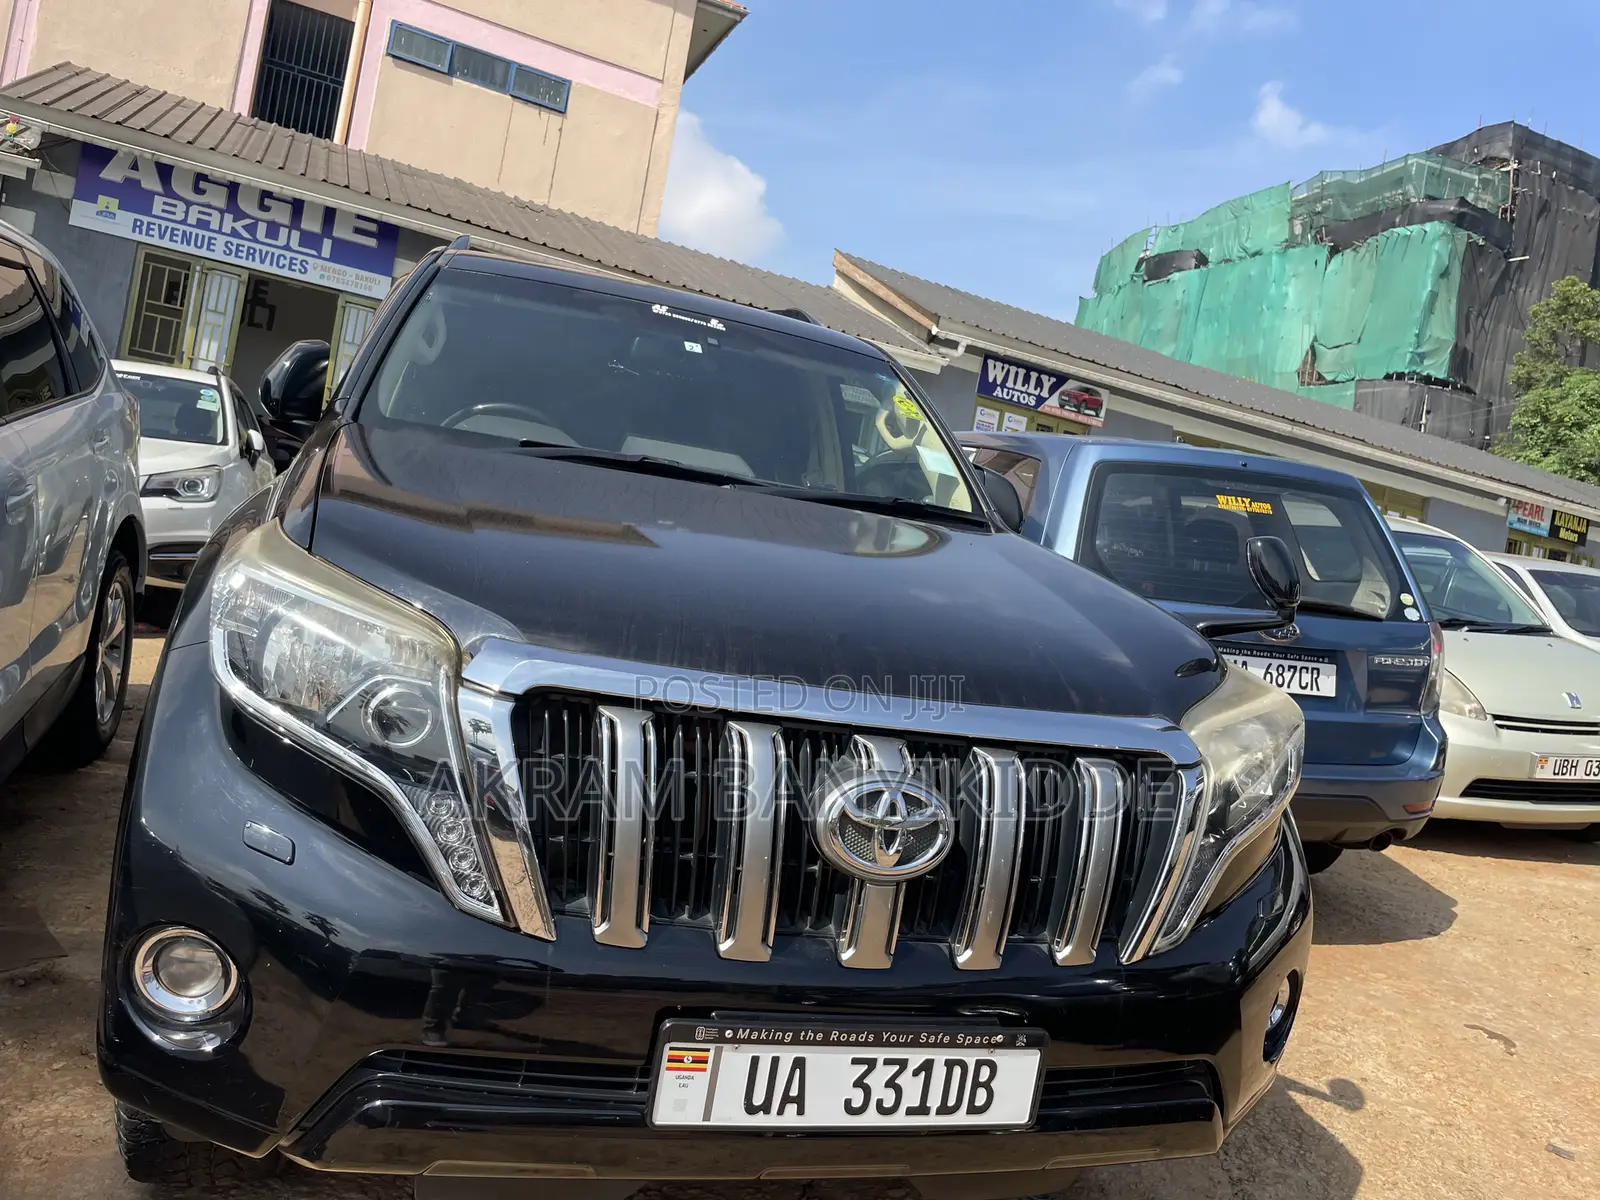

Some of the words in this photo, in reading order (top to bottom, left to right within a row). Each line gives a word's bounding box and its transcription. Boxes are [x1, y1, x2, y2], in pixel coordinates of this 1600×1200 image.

[99, 150, 378, 248] AGGIE
[152, 195, 333, 259] BAKULI
[131, 217, 217, 253] REVENUE
[222, 240, 310, 275] SERVICES
[987, 359, 1056, 399] WILLY
[993, 385, 1037, 407] AUTOS
[1216, 494, 1251, 508] WILLY
[1514, 499, 1545, 522] PEARL
[1554, 510, 1587, 534] KAYANJA
[1262, 662, 1321, 692] 687CR
[1552, 758, 1580, 777] UBH
[736, 1028, 794, 1043] Making
[799, 1029, 824, 1041] the
[830, 1030, 875, 1042] Roads
[881, 1031, 914, 1043] Your
[919, 1032, 950, 1044] Safe
[956, 1033, 997, 1046] Space
[743, 1055, 806, 1115] UA
[843, 1056, 998, 1116] 331DB
